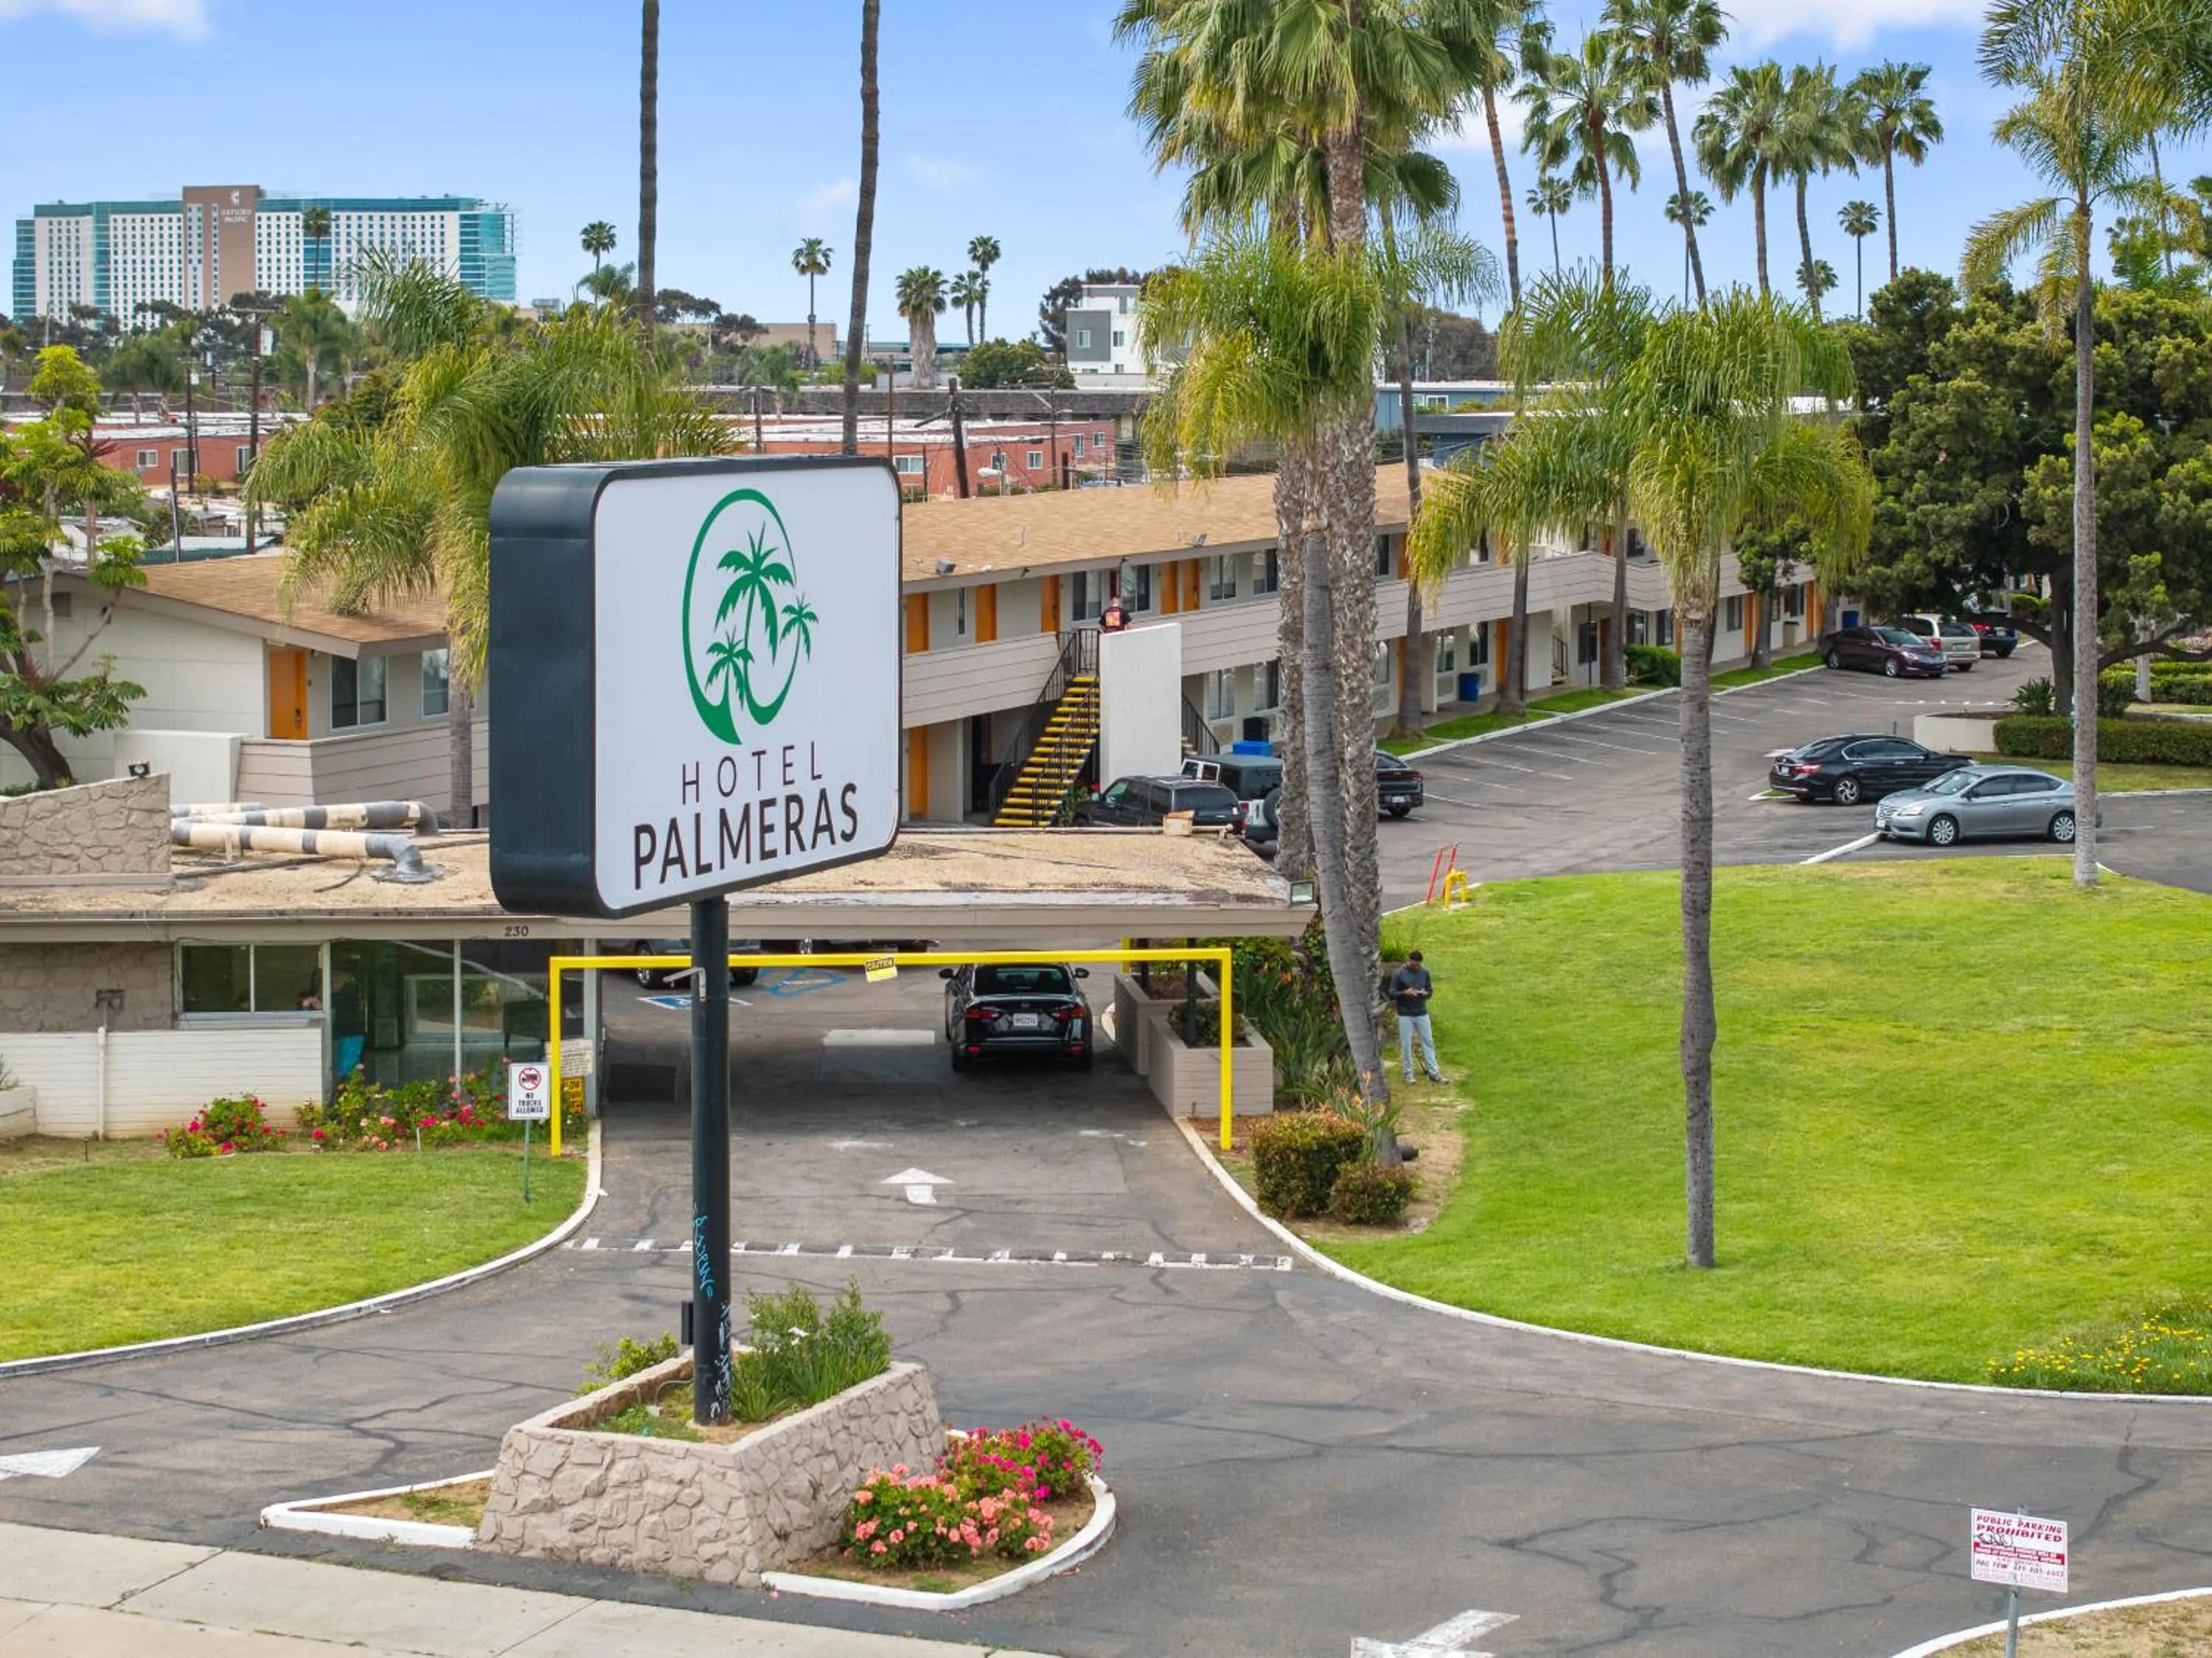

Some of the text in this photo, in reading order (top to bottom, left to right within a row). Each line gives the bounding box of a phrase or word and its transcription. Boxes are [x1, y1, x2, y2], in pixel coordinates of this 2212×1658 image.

[683, 741, 822, 805] HOTEL
[634, 782, 859, 891] PALMERAS
[504, 926, 529, 937] 230
[1976, 1514, 2062, 1534] PUBLIC PARKING
[1976, 1524, 2062, 1542] PROHIBITED
